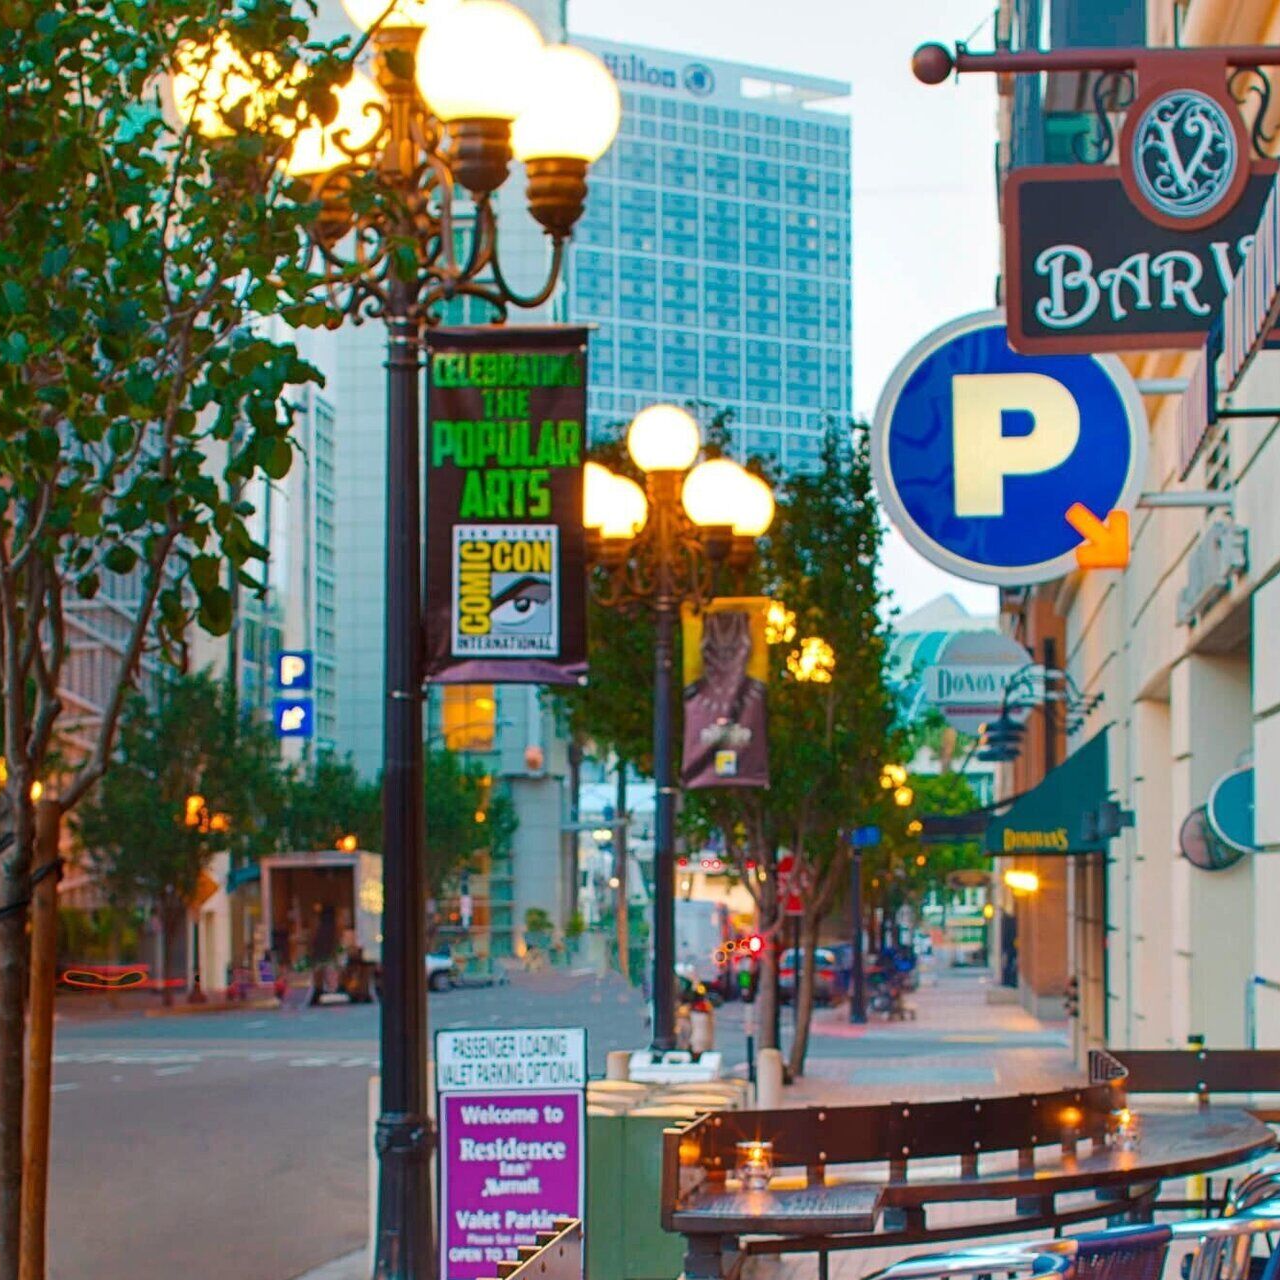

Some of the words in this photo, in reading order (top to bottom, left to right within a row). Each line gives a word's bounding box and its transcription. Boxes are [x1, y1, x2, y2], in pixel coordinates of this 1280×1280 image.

[480, 389, 531, 418] THE
[432, 420, 581, 468] POPULAR
[952, 372, 1081, 518] P
[460, 469, 552, 518] ARTS
[492, 541, 552, 572] CON
[460, 542, 491, 635] COMIC
[280, 655, 306, 686] P
[460, 1104, 539, 1125] Welcome
[543, 1105, 564, 1124] to
[459, 1137, 566, 1161] Residence
[455, 1209, 501, 1230] Valet
[505, 1209, 569, 1230] Parkin
